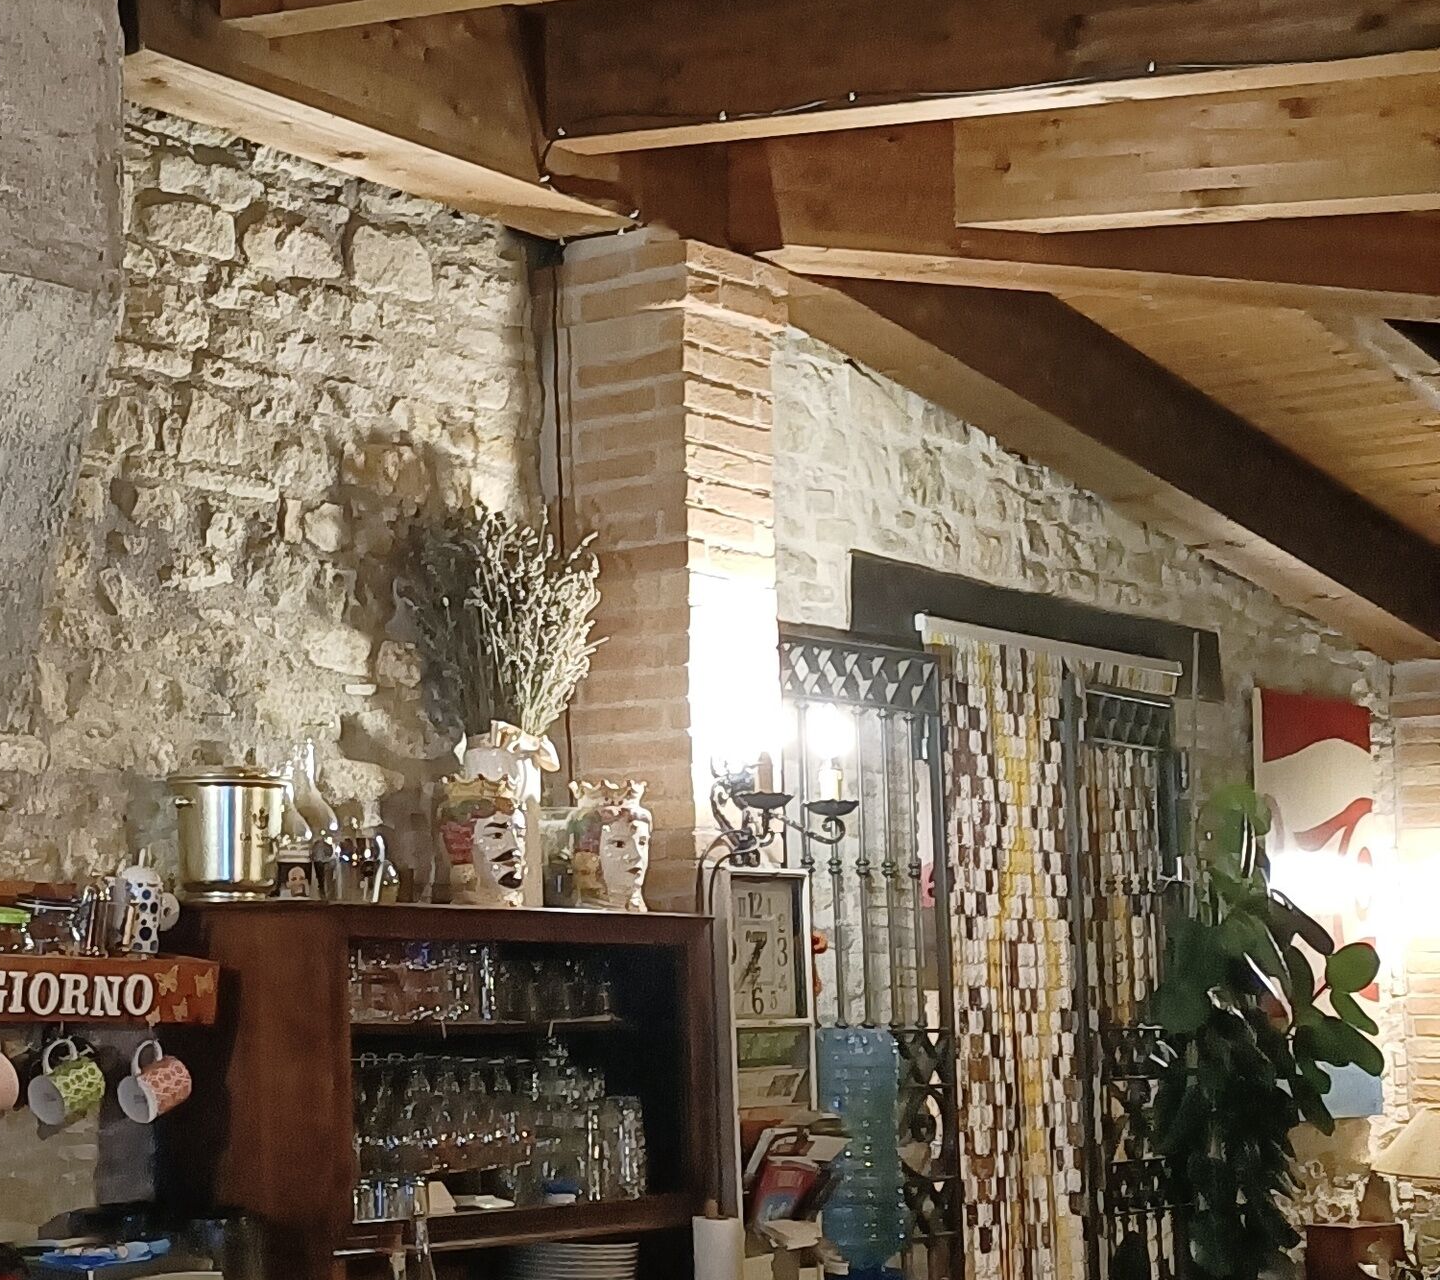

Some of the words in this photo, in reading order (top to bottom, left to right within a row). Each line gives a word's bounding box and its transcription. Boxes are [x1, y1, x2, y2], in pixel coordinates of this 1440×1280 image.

[748, 891, 762, 918] 12
[776, 936, 788, 967] 3
[751, 986, 764, 1015] 6
